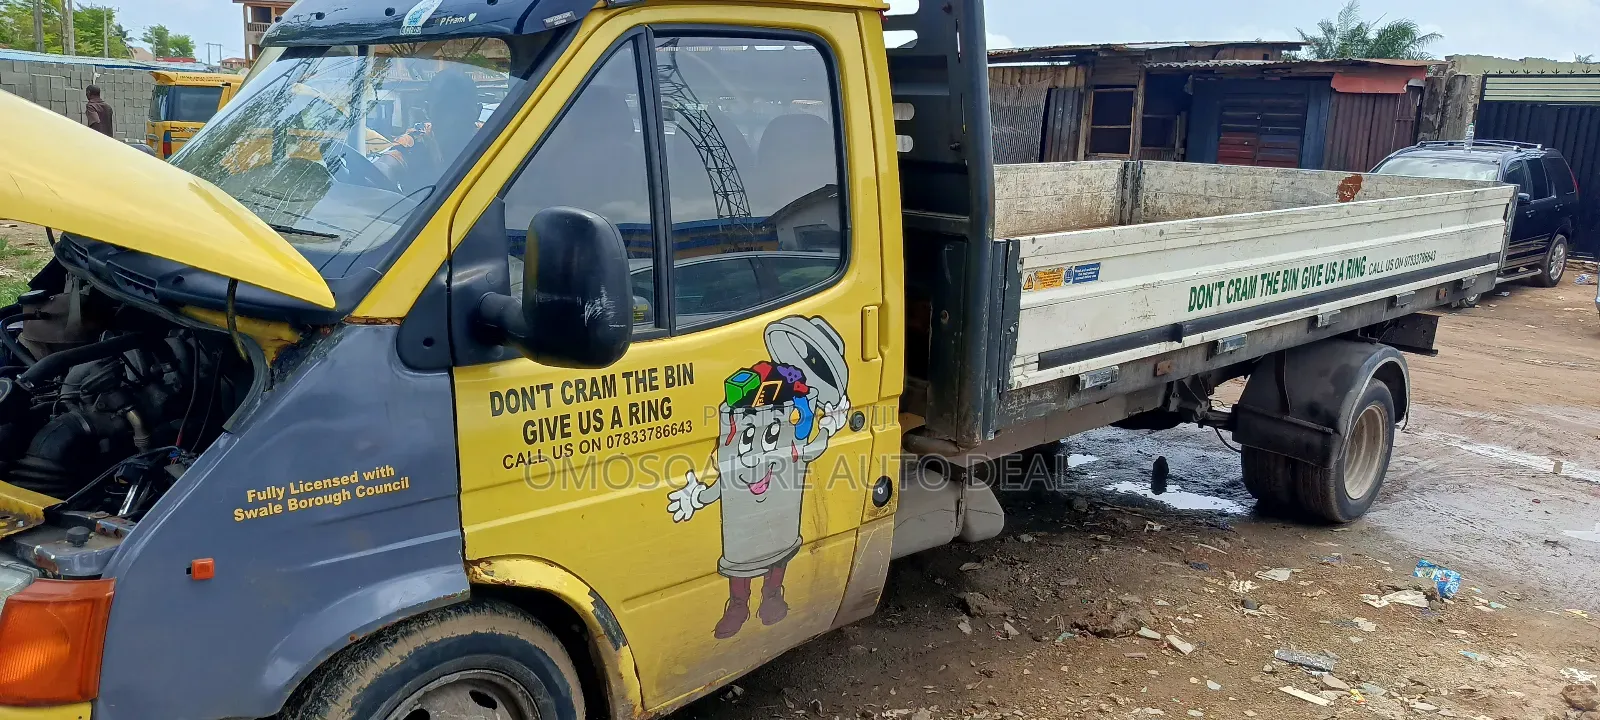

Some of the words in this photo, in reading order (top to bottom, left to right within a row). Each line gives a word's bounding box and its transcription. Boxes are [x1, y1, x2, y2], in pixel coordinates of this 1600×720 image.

[1187, 280, 1225, 312] DON'T
[1226, 274, 1258, 303] CRAM
[1260, 270, 1280, 297] THE
[1281, 267, 1299, 293] BIN
[1301, 263, 1323, 289] GIVE
[1324, 261, 1337, 284] US
[1337, 260, 1345, 282] A
[1345, 255, 1367, 280] RING
[1368, 260, 1384, 276] CALL
[1385, 258, 1394, 271] US
[1394, 256, 1404, 270] ON
[489, 382, 554, 417] DON'T
[560, 373, 617, 405] CRAM
[621, 367, 659, 395] THE
[664, 362, 695, 389] BIN
[502, 448, 548, 470] CALL
[552, 443, 574, 460] US
[578, 437, 602, 455] ON
[606, 419, 693, 449] 07833786643
[522, 413, 572, 445] GIVE
[577, 408, 604, 435] US
[610, 405, 623, 429] A
[628, 396, 673, 426] RING
[233, 502, 283, 522] Swale
[287, 488, 351, 512] Borough
[355, 476, 410, 498] Council
[246, 485, 285, 503] Fully
[289, 470, 359, 495] Licensed
[363, 464, 395, 481] with
